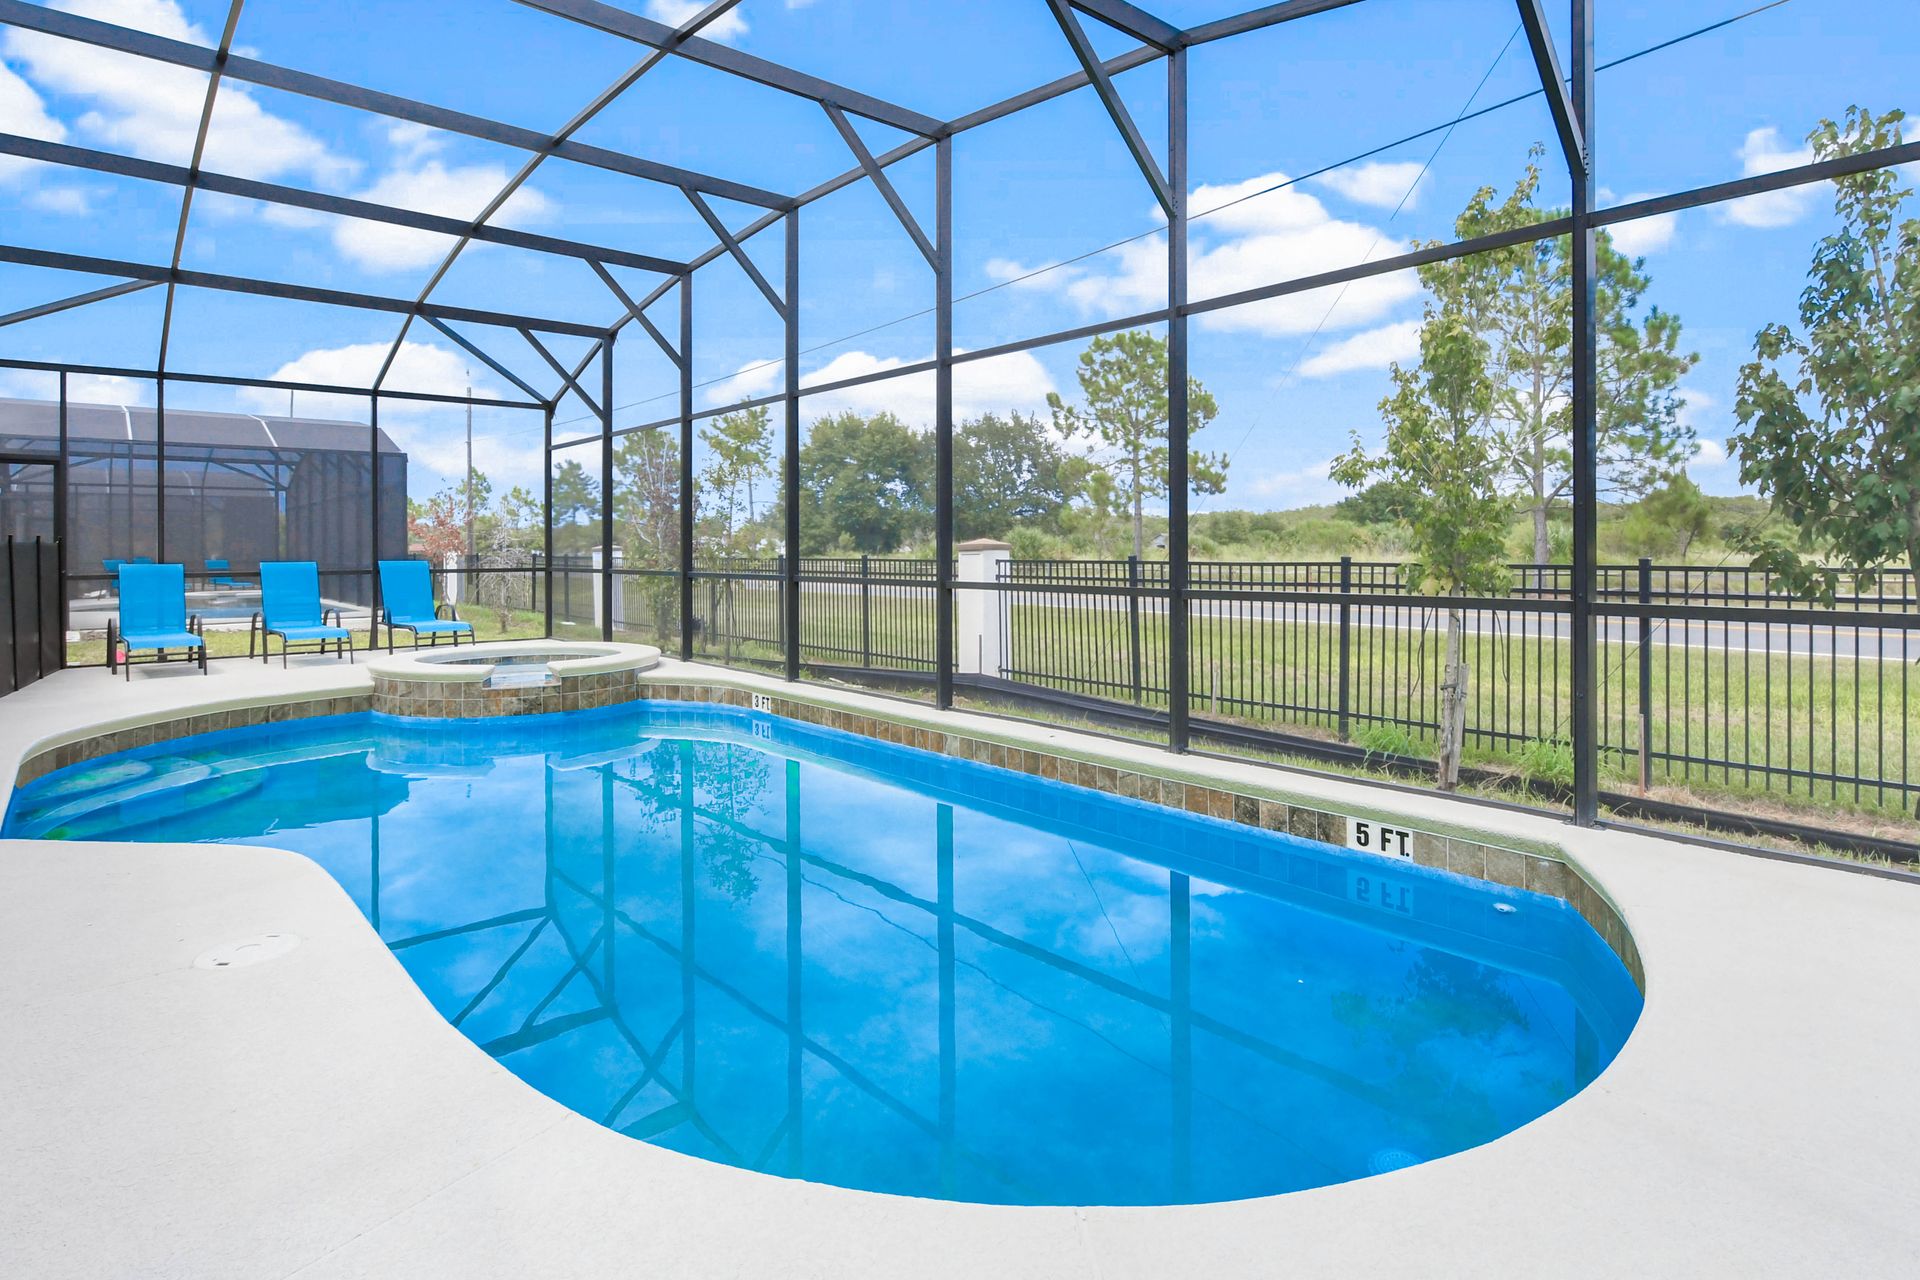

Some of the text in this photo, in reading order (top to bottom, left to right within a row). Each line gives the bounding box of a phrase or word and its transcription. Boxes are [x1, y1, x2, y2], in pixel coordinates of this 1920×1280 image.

[754, 695, 759, 707] 3
[1356, 822, 1410, 857] 5 FT.
